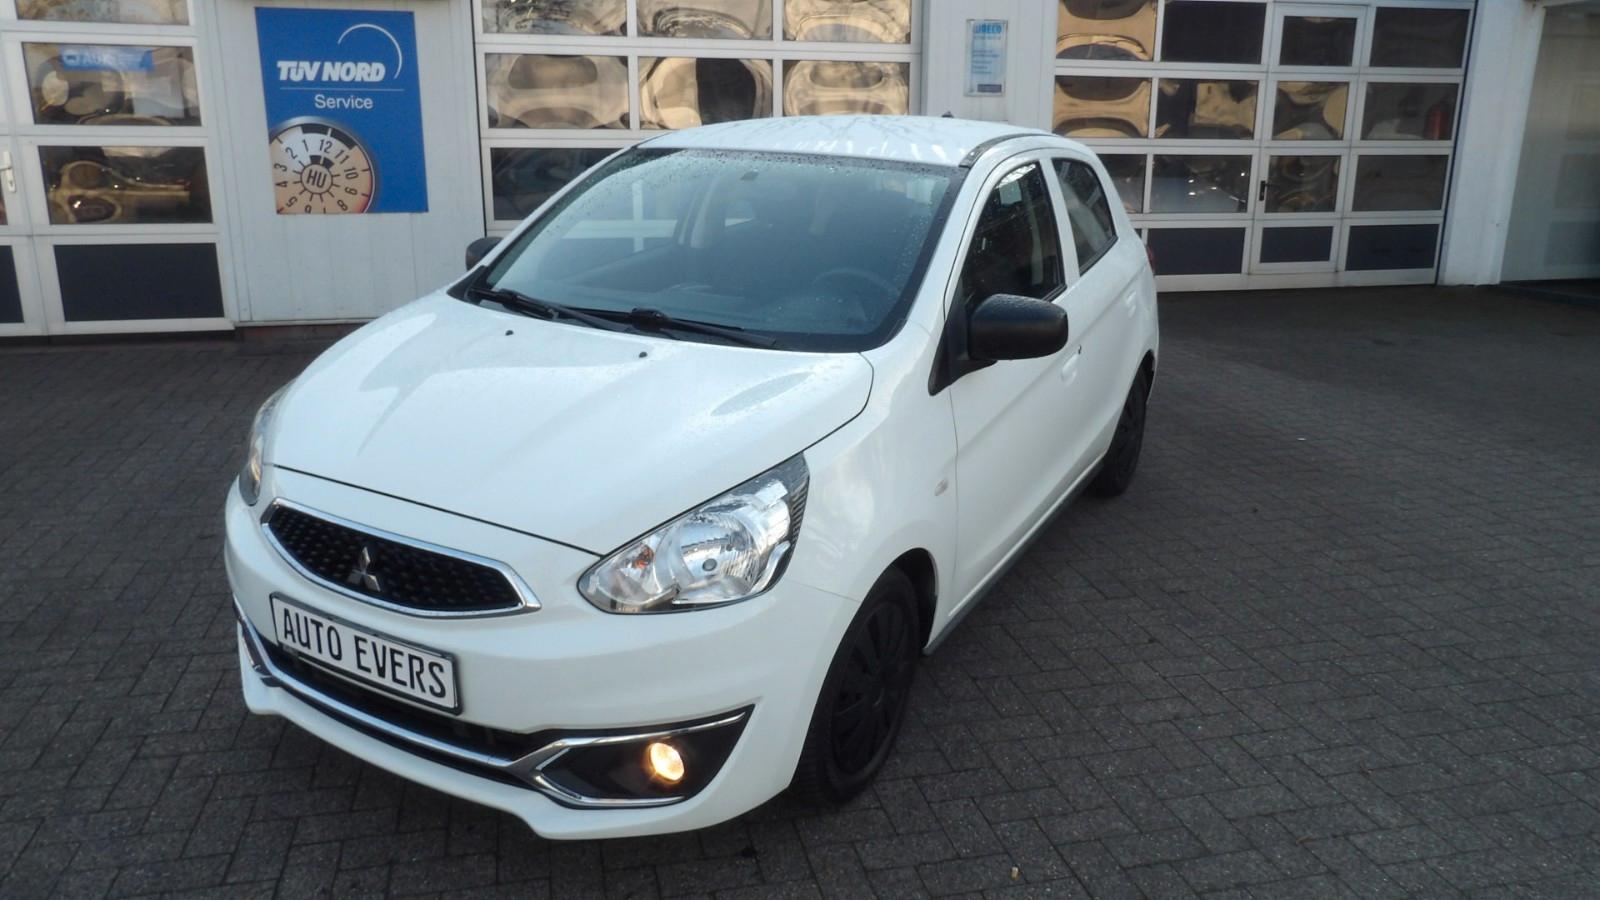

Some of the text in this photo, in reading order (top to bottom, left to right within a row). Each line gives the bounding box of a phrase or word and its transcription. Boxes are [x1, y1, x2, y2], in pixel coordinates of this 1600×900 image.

[276, 60, 386, 82] TÜV NORD
[314, 93, 373, 109] Service
[302, 139, 309, 152] 1
[319, 139, 333, 154] 12
[285, 147, 298, 159] 2
[334, 149, 349, 164] 11
[273, 163, 288, 172] 3
[344, 167, 359, 180] 10
[306, 169, 327, 188] HU
[344, 186, 358, 196] 9
[286, 196, 298, 207] 5
[336, 199, 348, 211] 8
[283, 607, 447, 699] AUTO EVERS
